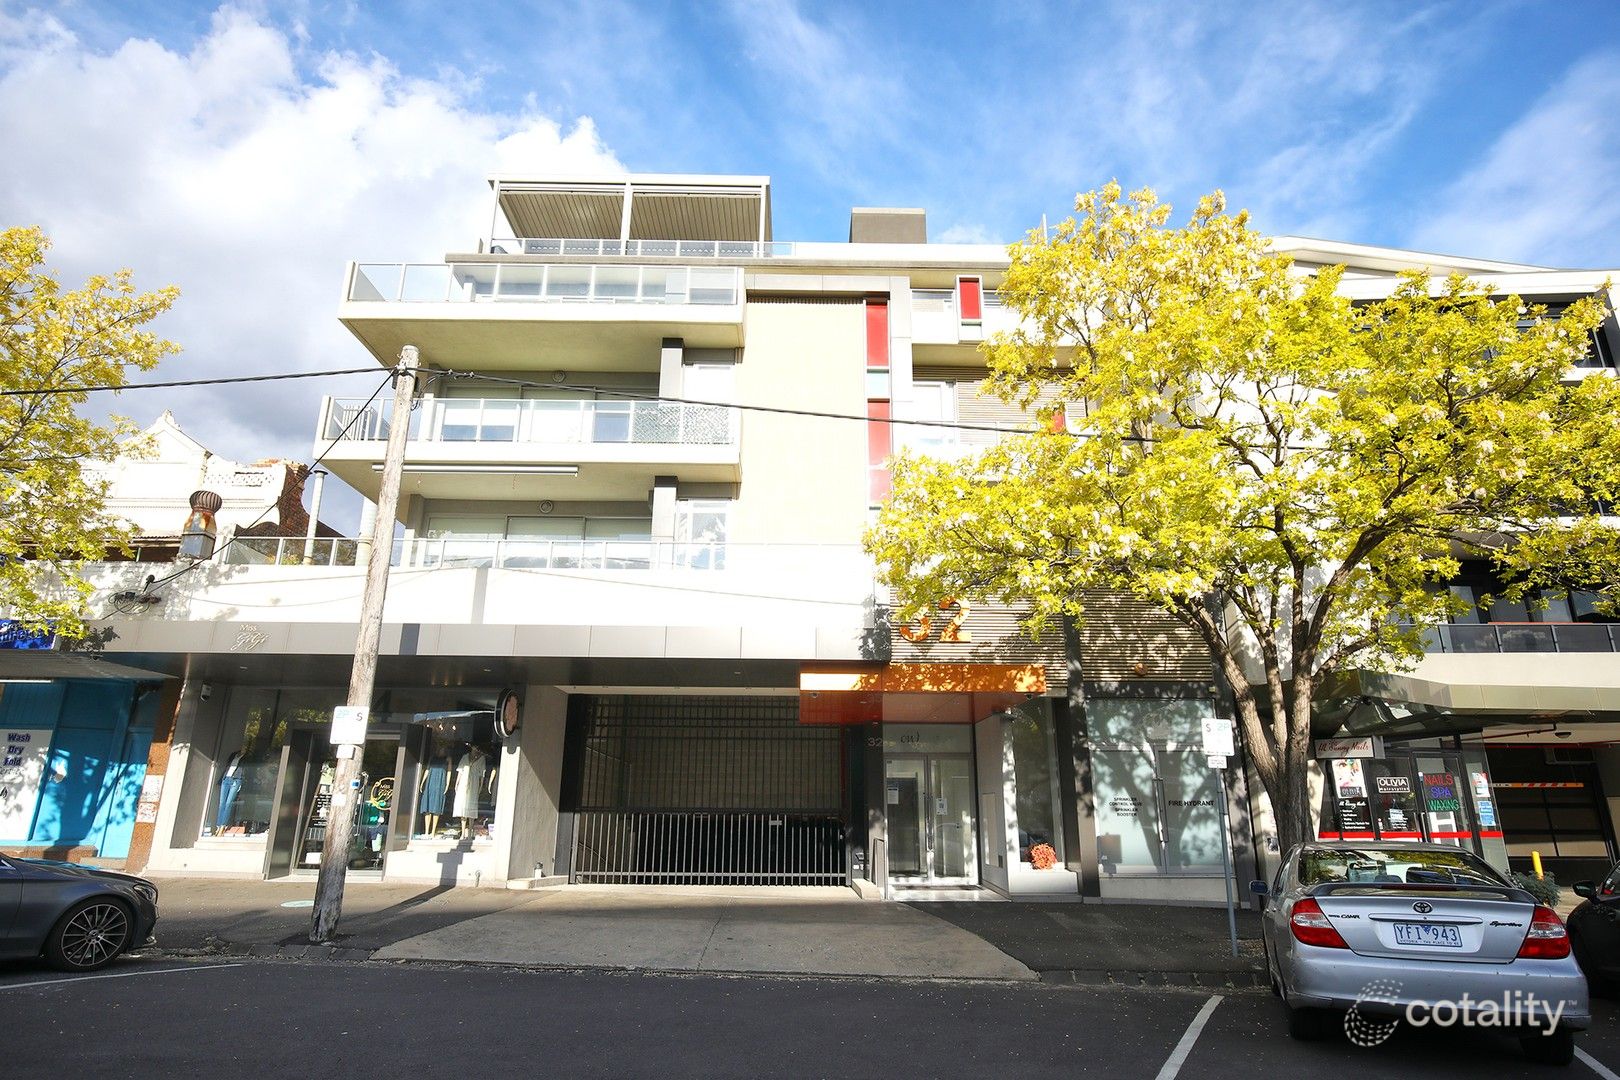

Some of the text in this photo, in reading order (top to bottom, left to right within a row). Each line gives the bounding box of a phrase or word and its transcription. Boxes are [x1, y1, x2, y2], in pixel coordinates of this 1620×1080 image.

[355, 712, 363, 721] S
[7, 732, 31, 742] Wash
[7, 745, 25, 755] Dry
[1424, 774, 1453, 786] NAILS
[1431, 787, 1452, 798] SPA
[1428, 800, 1459, 811] WAXING
[1431, 928, 1458, 941] 943
